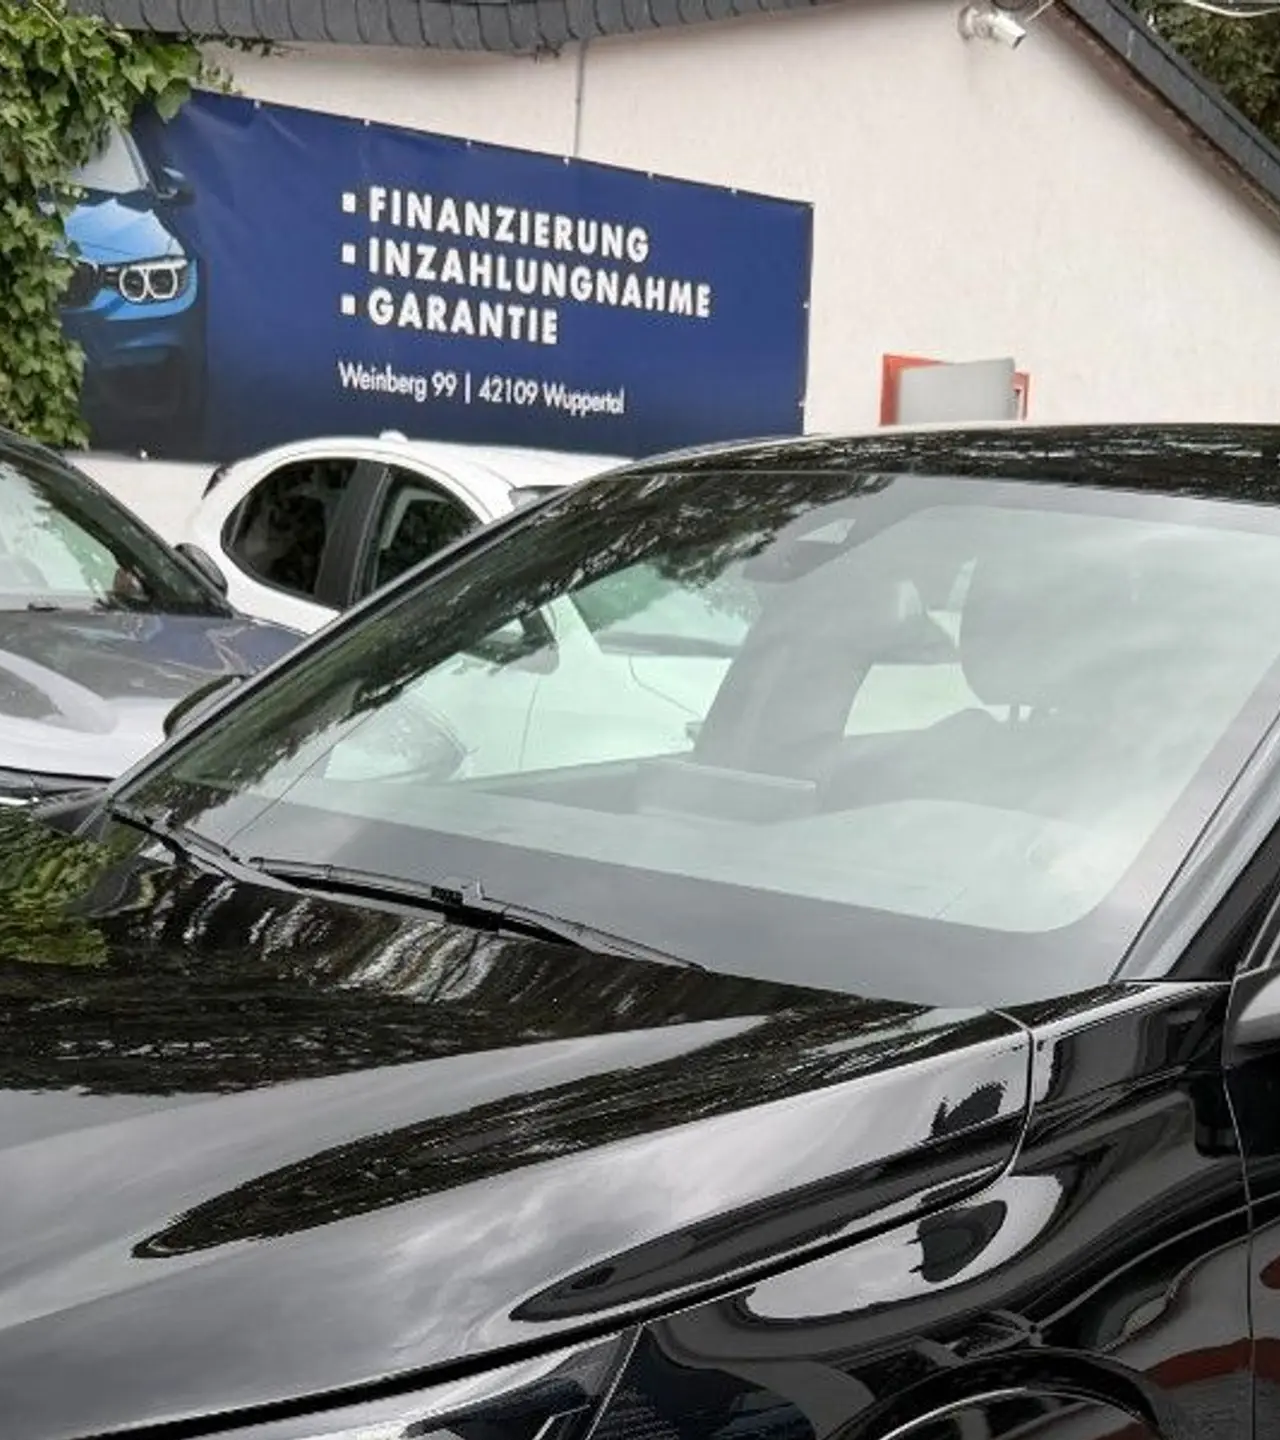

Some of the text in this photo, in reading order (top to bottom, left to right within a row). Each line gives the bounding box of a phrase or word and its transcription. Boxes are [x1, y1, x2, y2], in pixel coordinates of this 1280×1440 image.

[369, 186, 649, 263] FINANZIERUNG
[369, 237, 710, 318] INZAHLUNGNAHME
[368, 287, 558, 345] GARANTIE
[338, 361, 427, 402] Weinberg
[431, 372, 458, 397] 99
[478, 375, 538, 405] 42109
[542, 381, 625, 416] Wuppertal
